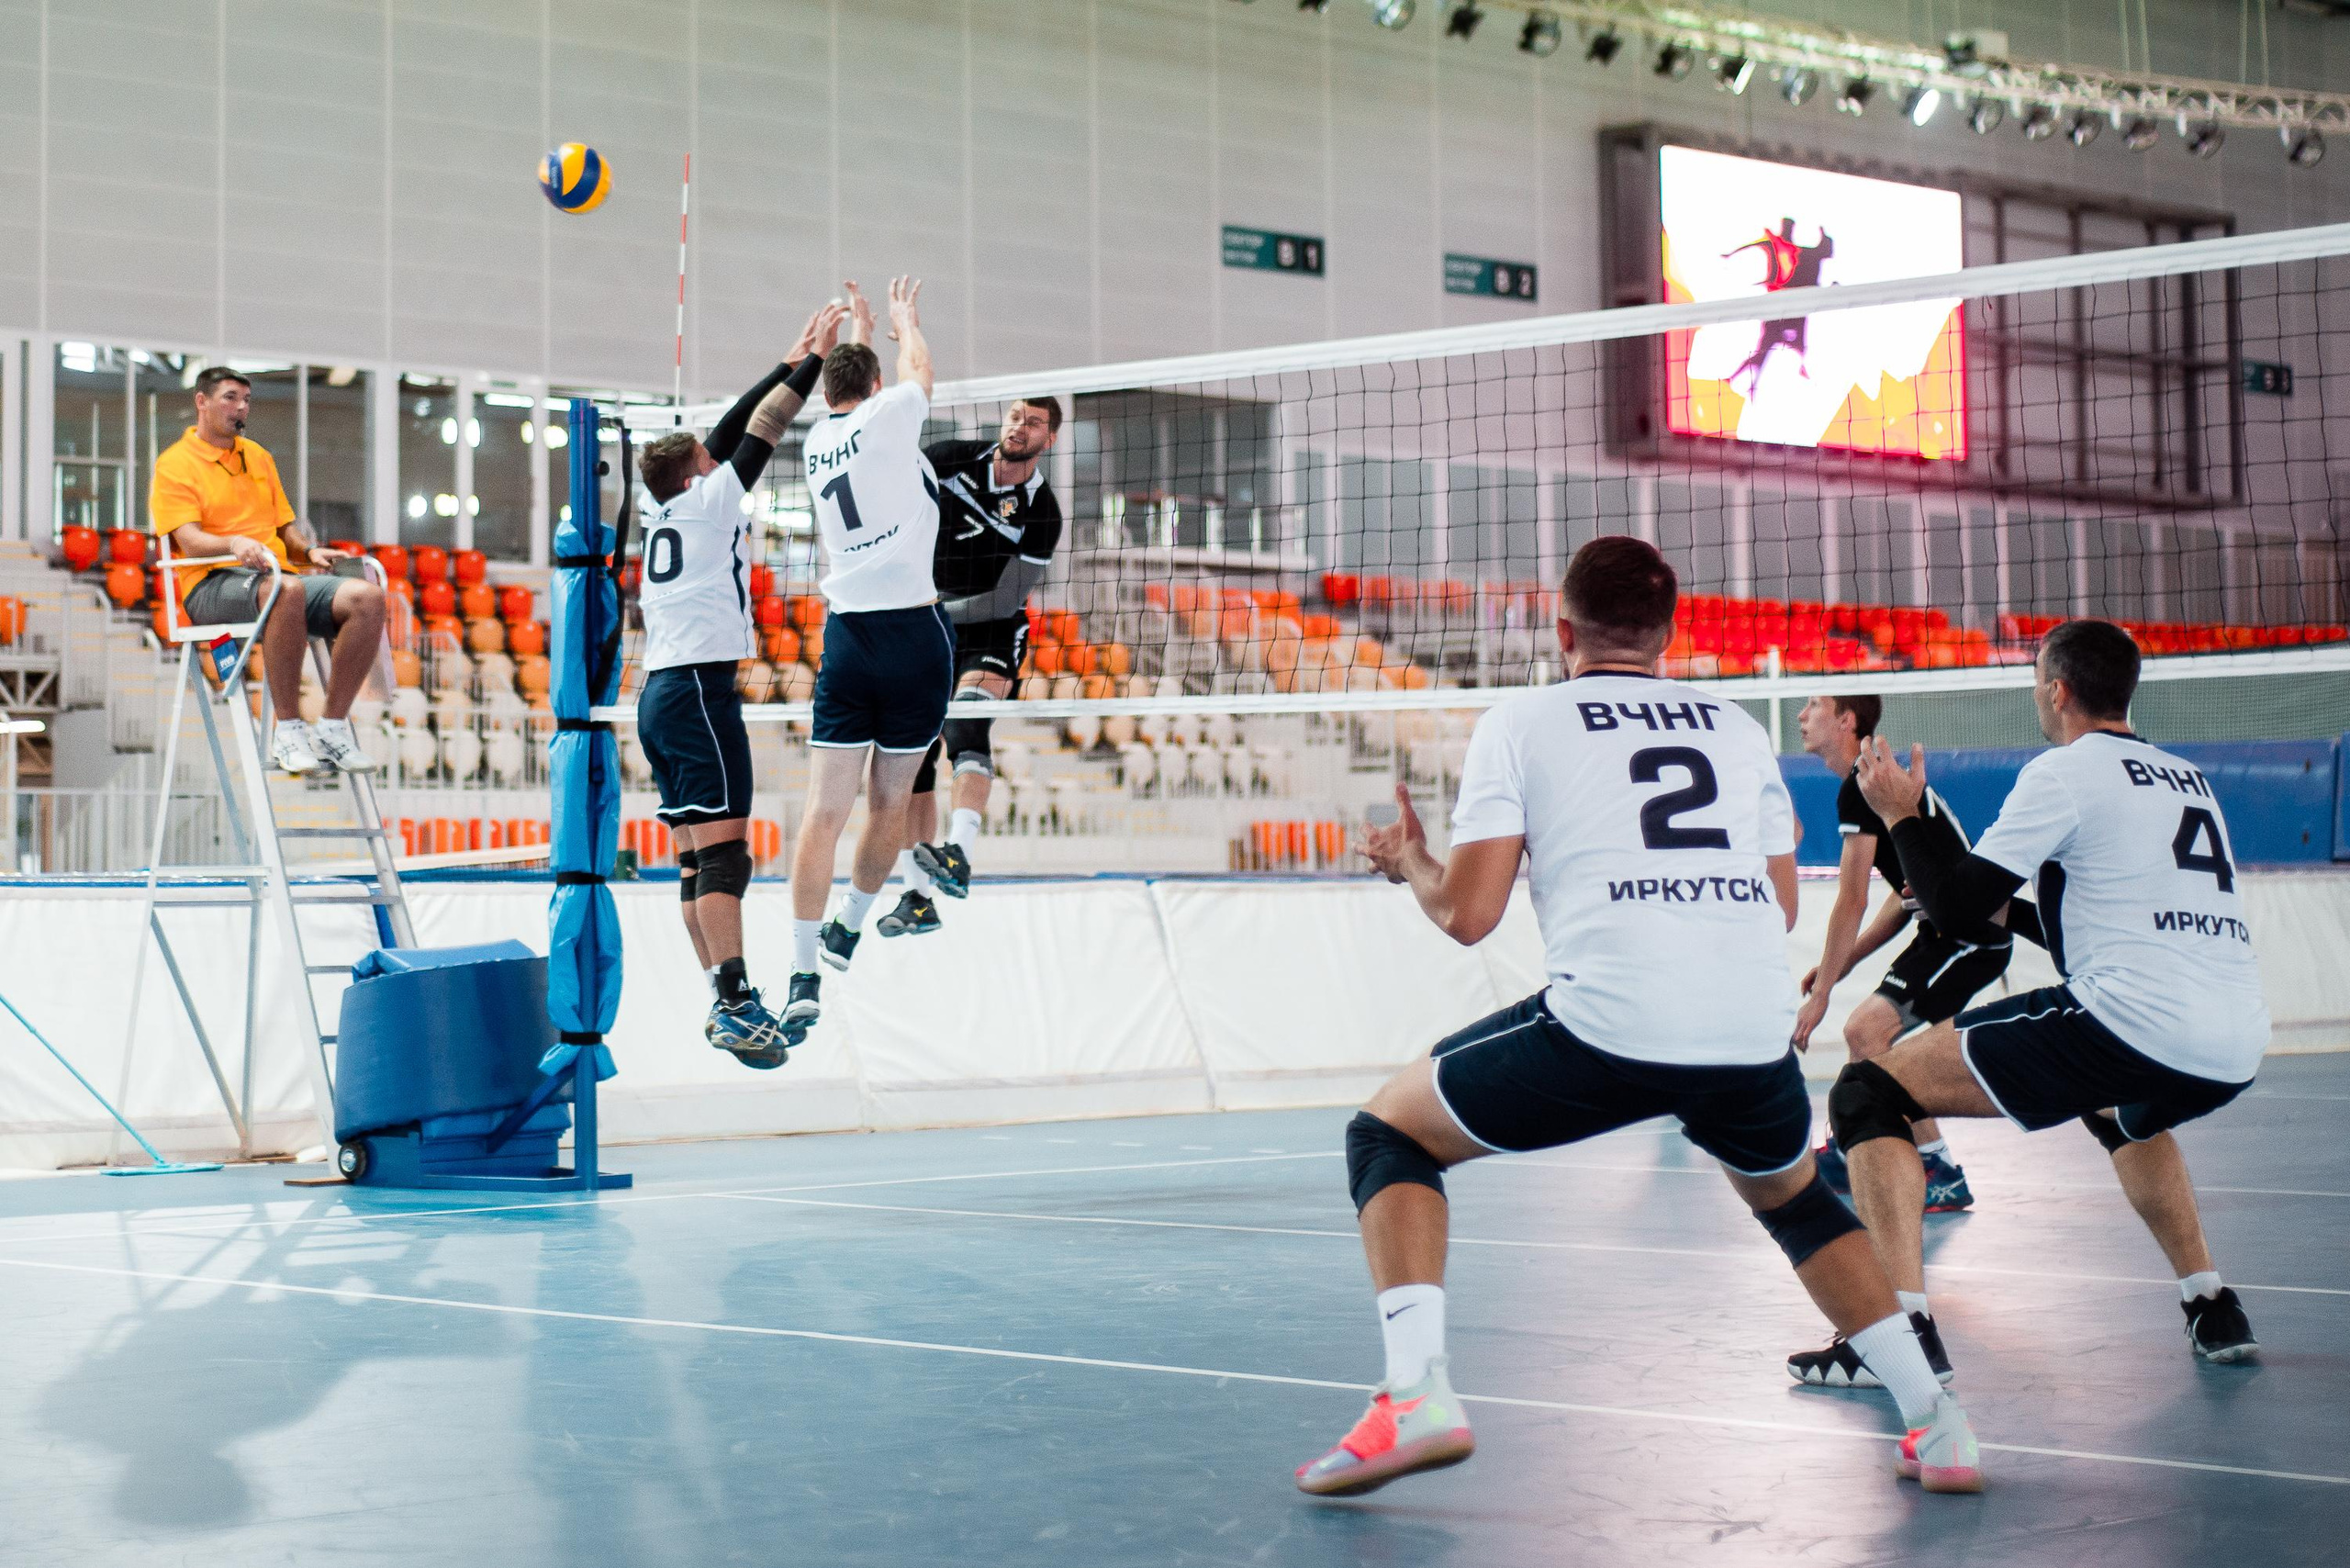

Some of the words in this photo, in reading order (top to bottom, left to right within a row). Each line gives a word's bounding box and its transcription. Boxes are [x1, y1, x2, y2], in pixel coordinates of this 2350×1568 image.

[809, 429, 861, 475] ВЧНГ
[821, 472, 863, 532] 1
[1576, 701, 1720, 732] ВЧНГ
[1628, 745, 1731, 850] 2
[2171, 805, 2234, 894] 4
[1608, 877, 1771, 903] ИРКУТСК
